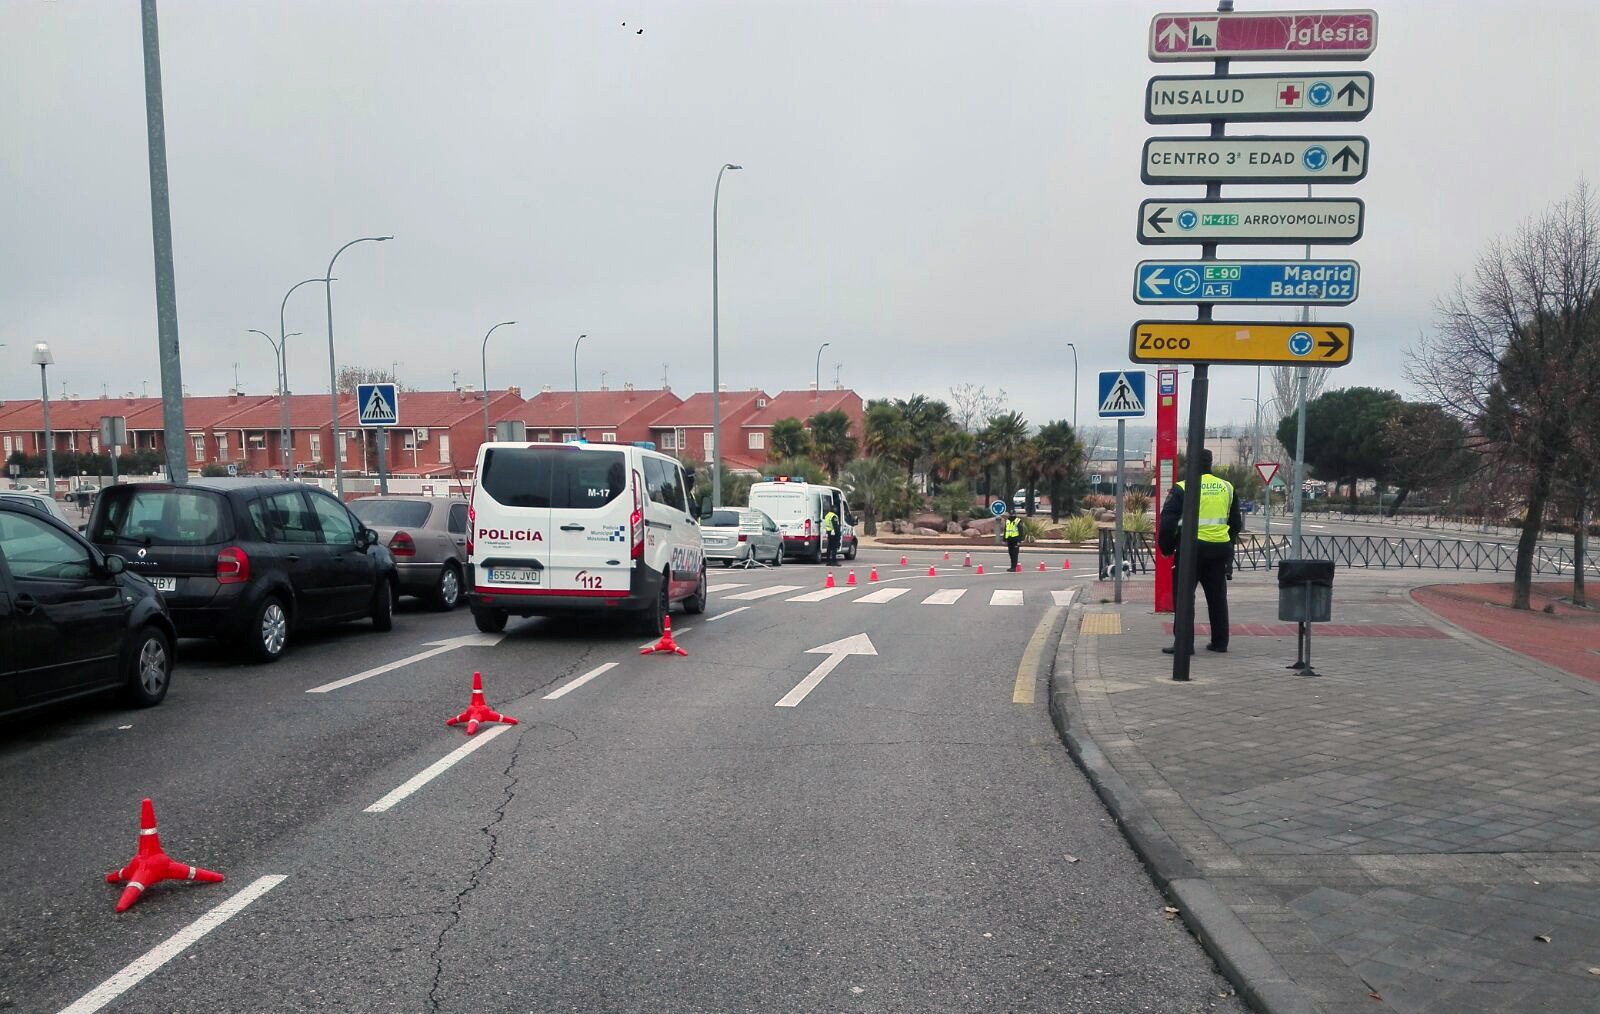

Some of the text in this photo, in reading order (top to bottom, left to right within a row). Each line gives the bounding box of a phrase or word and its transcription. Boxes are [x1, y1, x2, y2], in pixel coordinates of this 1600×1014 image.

[1154, 89, 1245, 106] INSALUD
[1150, 152, 1220, 165] CENTRO
[1249, 152, 1295, 165] EDAD
[1202, 214, 1356, 225] M-413 ARROYOMOLINOS
[1205, 267, 1239, 279] E-90
[1284, 266, 1352, 281] Madrid
[1203, 284, 1230, 295] A-5
[1271, 281, 1350, 298] Badajoz
[1139, 333, 1191, 350] Zoco
[588, 488, 611, 498] M-17
[479, 528, 543, 541] POLICÍA
[494, 570, 516, 580] 6554
[581, 576, 602, 589] 112
